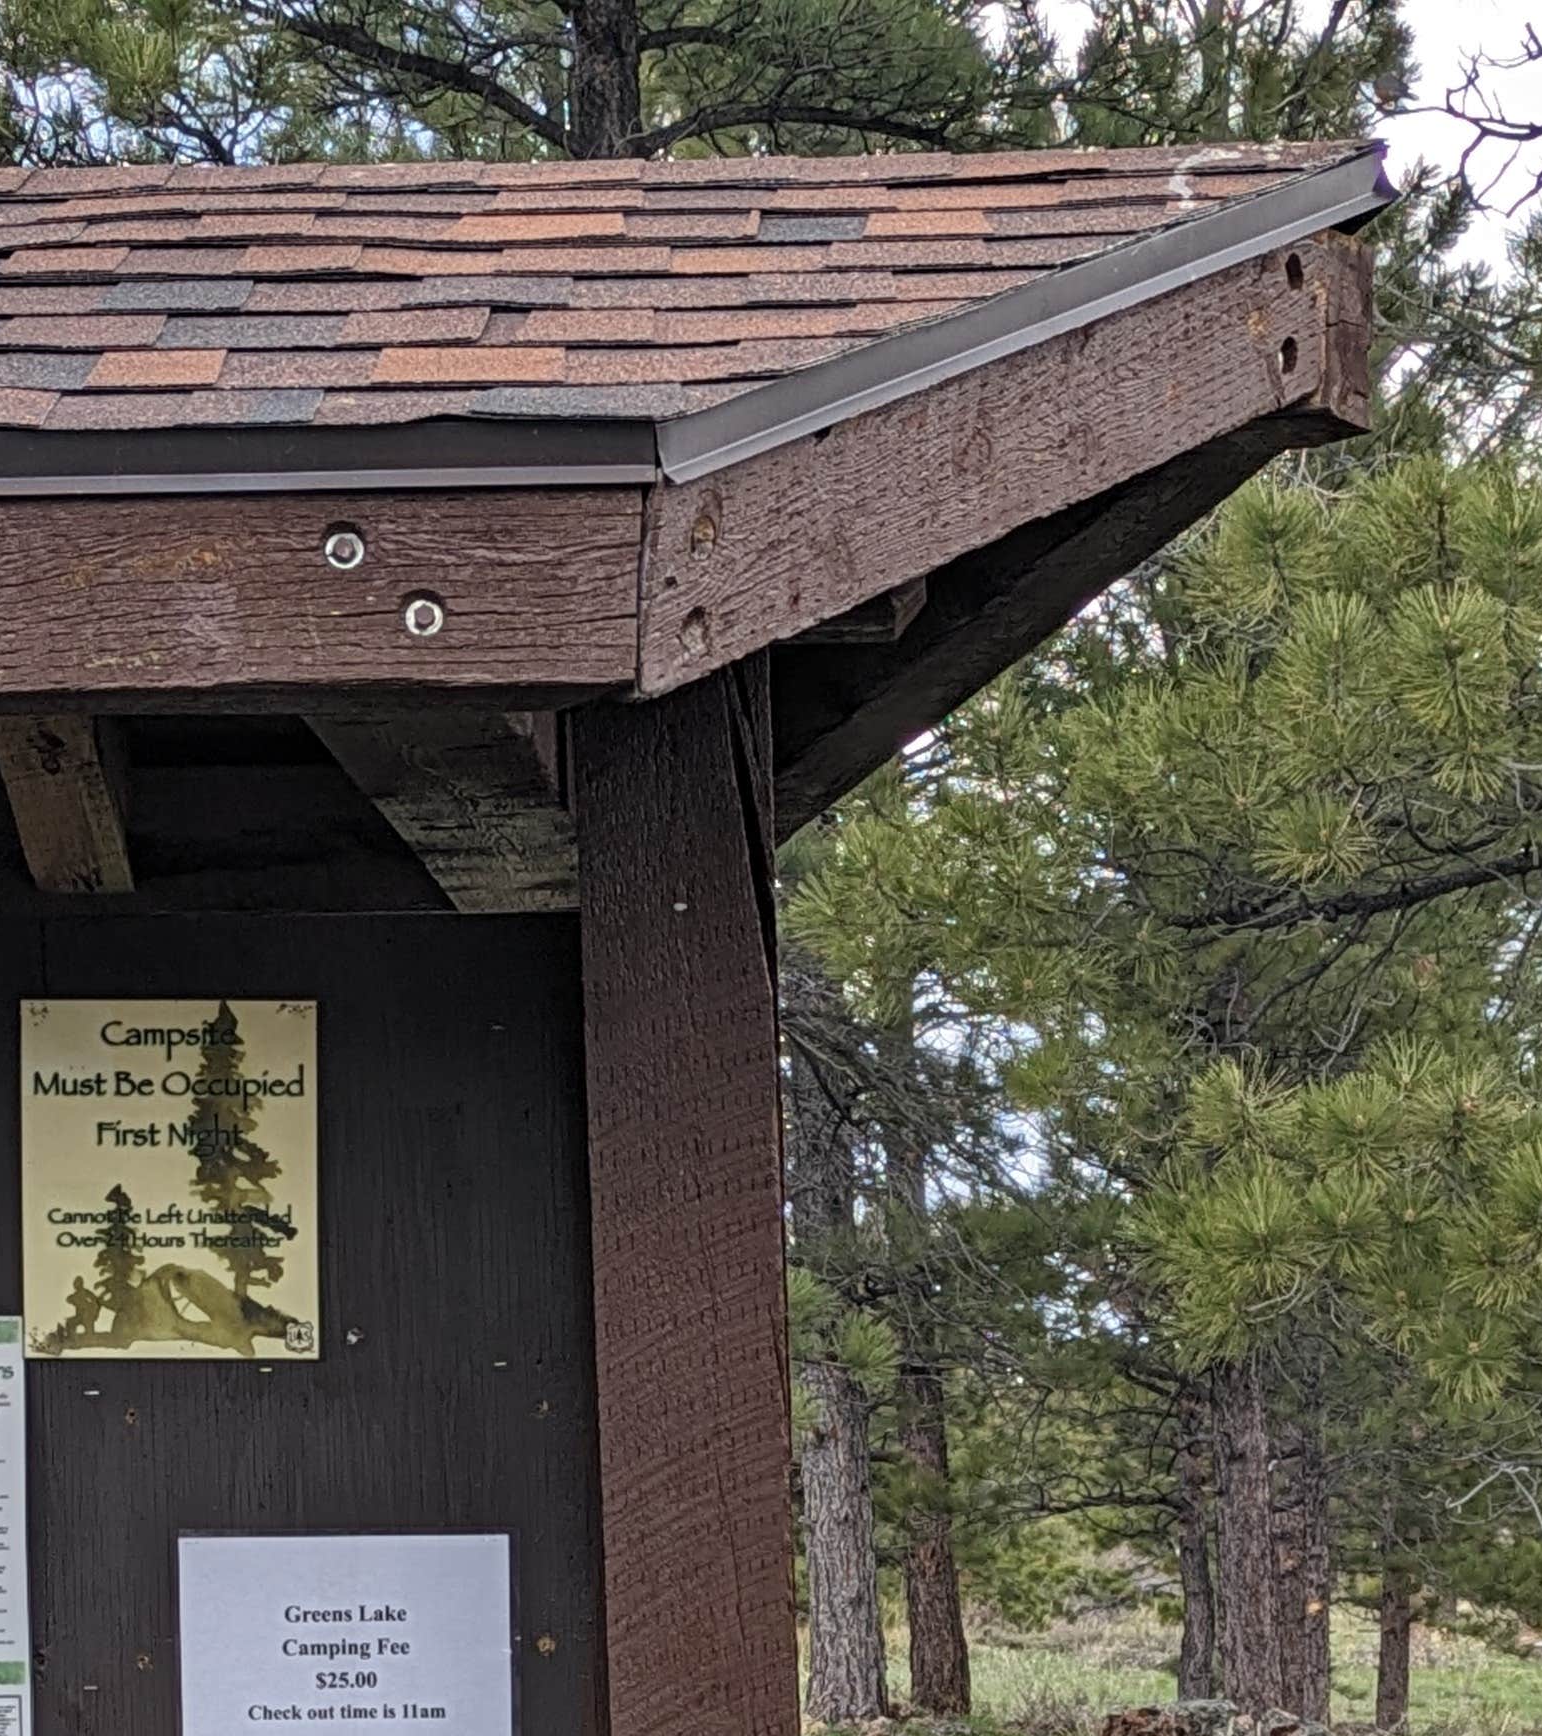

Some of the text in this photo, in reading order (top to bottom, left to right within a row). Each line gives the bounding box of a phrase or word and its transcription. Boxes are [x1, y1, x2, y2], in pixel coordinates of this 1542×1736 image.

[101, 1020, 236, 1061] Campsite
[33, 1063, 304, 1112] Must Be Occupied
[96, 1113, 244, 1157] First Night
[47, 1203, 292, 1225] Cannot Be Left Unattended
[56, 1231, 102, 1248] Over
[132, 1231, 186, 1248] Hours
[189, 1227, 285, 1248] Thereafter
[284, 1604, 407, 1623] Greens Lake
[282, 1638, 410, 1660] Camping Fee
[316, 1671, 377, 1690] $25.00
[248, 1703, 447, 1721] Check out time is 11am
